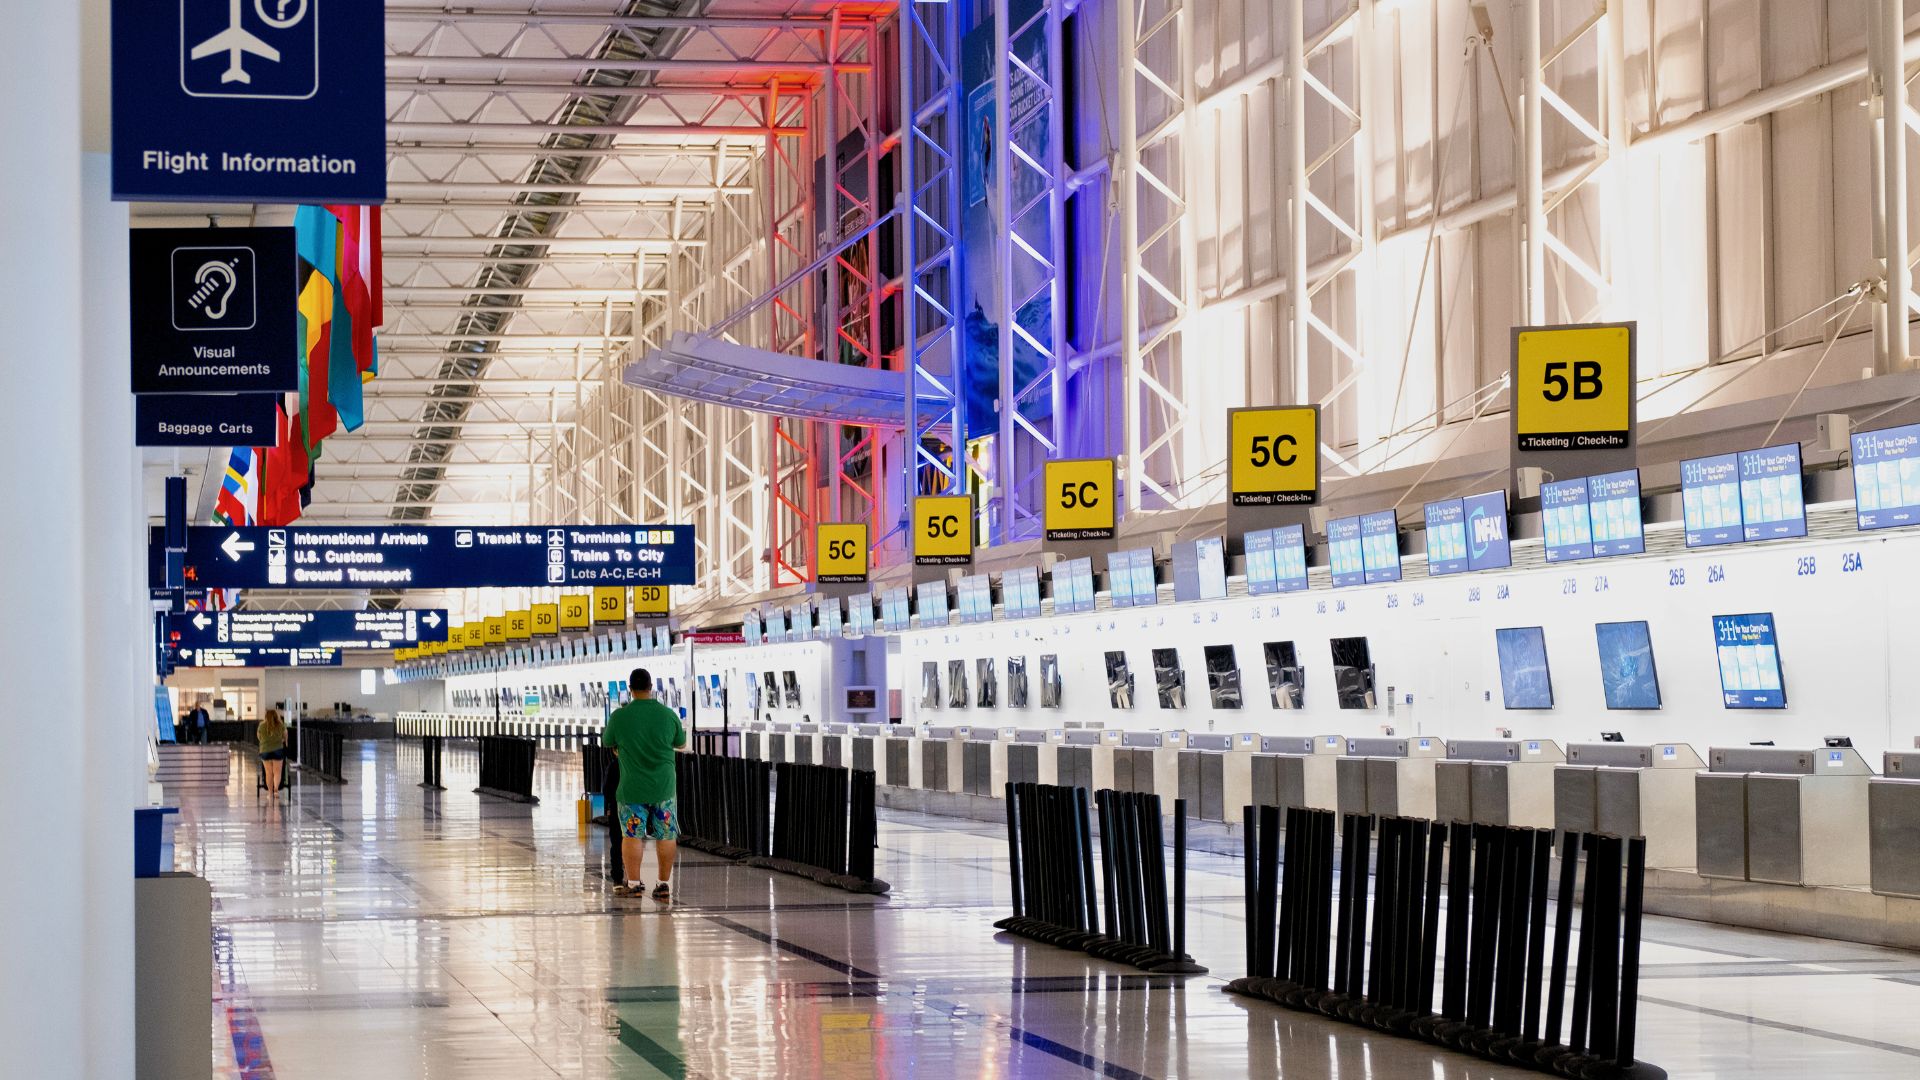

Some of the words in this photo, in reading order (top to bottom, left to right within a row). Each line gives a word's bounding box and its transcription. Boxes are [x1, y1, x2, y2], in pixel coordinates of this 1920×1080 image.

[142, 150, 208, 174] Flight
[222, 152, 356, 174] Information
[194, 346, 235, 358] Visual
[158, 364, 270, 376] Announcements
[1542, 361, 1602, 402] 5B
[158, 422, 212, 434] Baggage
[219, 422, 253, 434] Carts
[1528, 438, 1568, 447] Ticketing
[1577, 436, 1618, 445] Check-In
[1857, 436, 1878, 459] 3-1-1
[1251, 434, 1297, 467] 5C
[1743, 454, 1762, 475] 3-1-1
[1061, 481, 1098, 509] 5C
[1240, 495, 1270, 503] Ticketing
[928, 515, 958, 538] 5C
[294, 533, 375, 545] International
[381, 533, 428, 545] Arrivals
[478, 532, 521, 544] Transit
[526, 532, 542, 544] to:
[570, 532, 631, 544] Terminals
[570, 550, 610, 562] Trains
[616, 550, 632, 562] To
[638, 549, 664, 563] City
[829, 540, 856, 560] 5C
[294, 551, 320, 563] U.S.
[326, 551, 383, 563] Customs
[1842, 552, 1862, 572] 25A
[1798, 557, 1816, 575] 25B
[294, 569, 342, 582] Ground
[348, 569, 412, 582] Transport
[571, 568, 596, 578] Lots
[1669, 568, 1685, 586] 26B
[1708, 565, 1725, 583] 26A
[1563, 579, 1576, 594] 27B
[1595, 576, 1609, 592] 27A
[642, 587, 660, 601] 5D
[1497, 584, 1510, 599] 28A
[601, 597, 618, 610] 5D
[567, 606, 582, 618] 5D
[512, 620, 524, 630] 5E
[537, 613, 551, 625] 5D
[470, 630, 480, 639] 5E
[490, 625, 501, 635] 5E
[1719, 620, 1737, 641] 3-1-1
[452, 634, 462, 643] 5E
